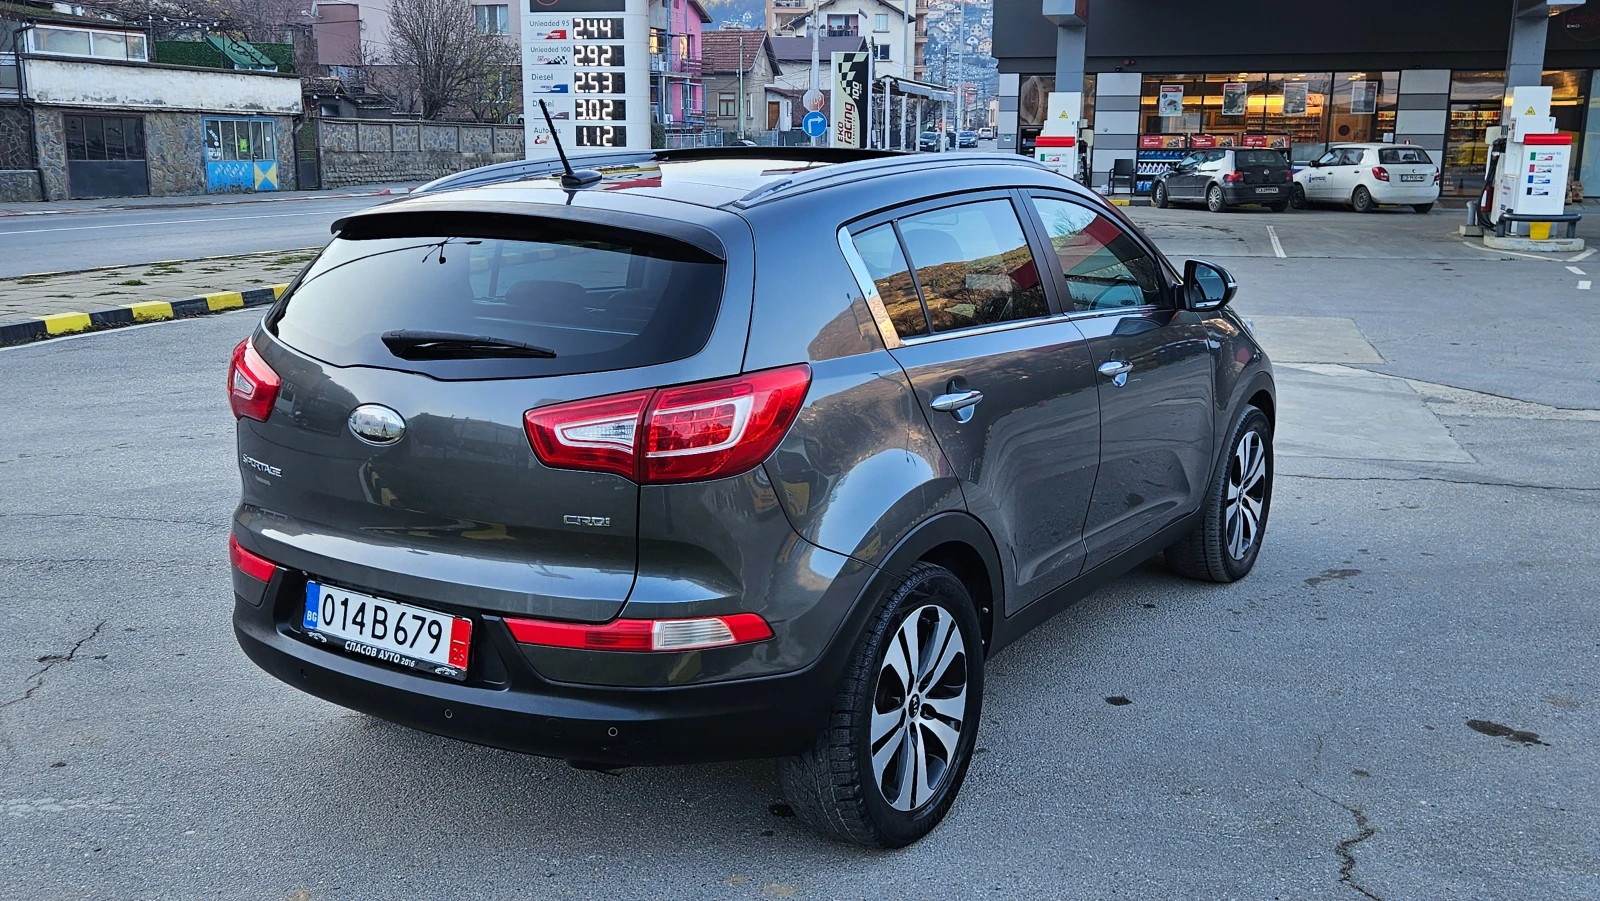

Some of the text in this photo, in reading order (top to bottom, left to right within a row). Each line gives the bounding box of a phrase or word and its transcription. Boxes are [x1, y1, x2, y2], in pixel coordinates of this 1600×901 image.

[573, 18, 611, 39] 2.44
[574, 45, 612, 66] 2.92
[531, 73, 553, 81] Diesel
[575, 72, 612, 93] 2.53
[852, 81, 860, 100] 100
[576, 99, 613, 120] 3.02
[844, 102, 856, 144] racing
[583, 126, 613, 147] 1.12
[242, 453, 282, 478] SPORTAGE
[306, 611, 318, 622] BG
[322, 593, 443, 654] 014B679
[344, 640, 416, 668] СПАСОВ АУТО 2016
